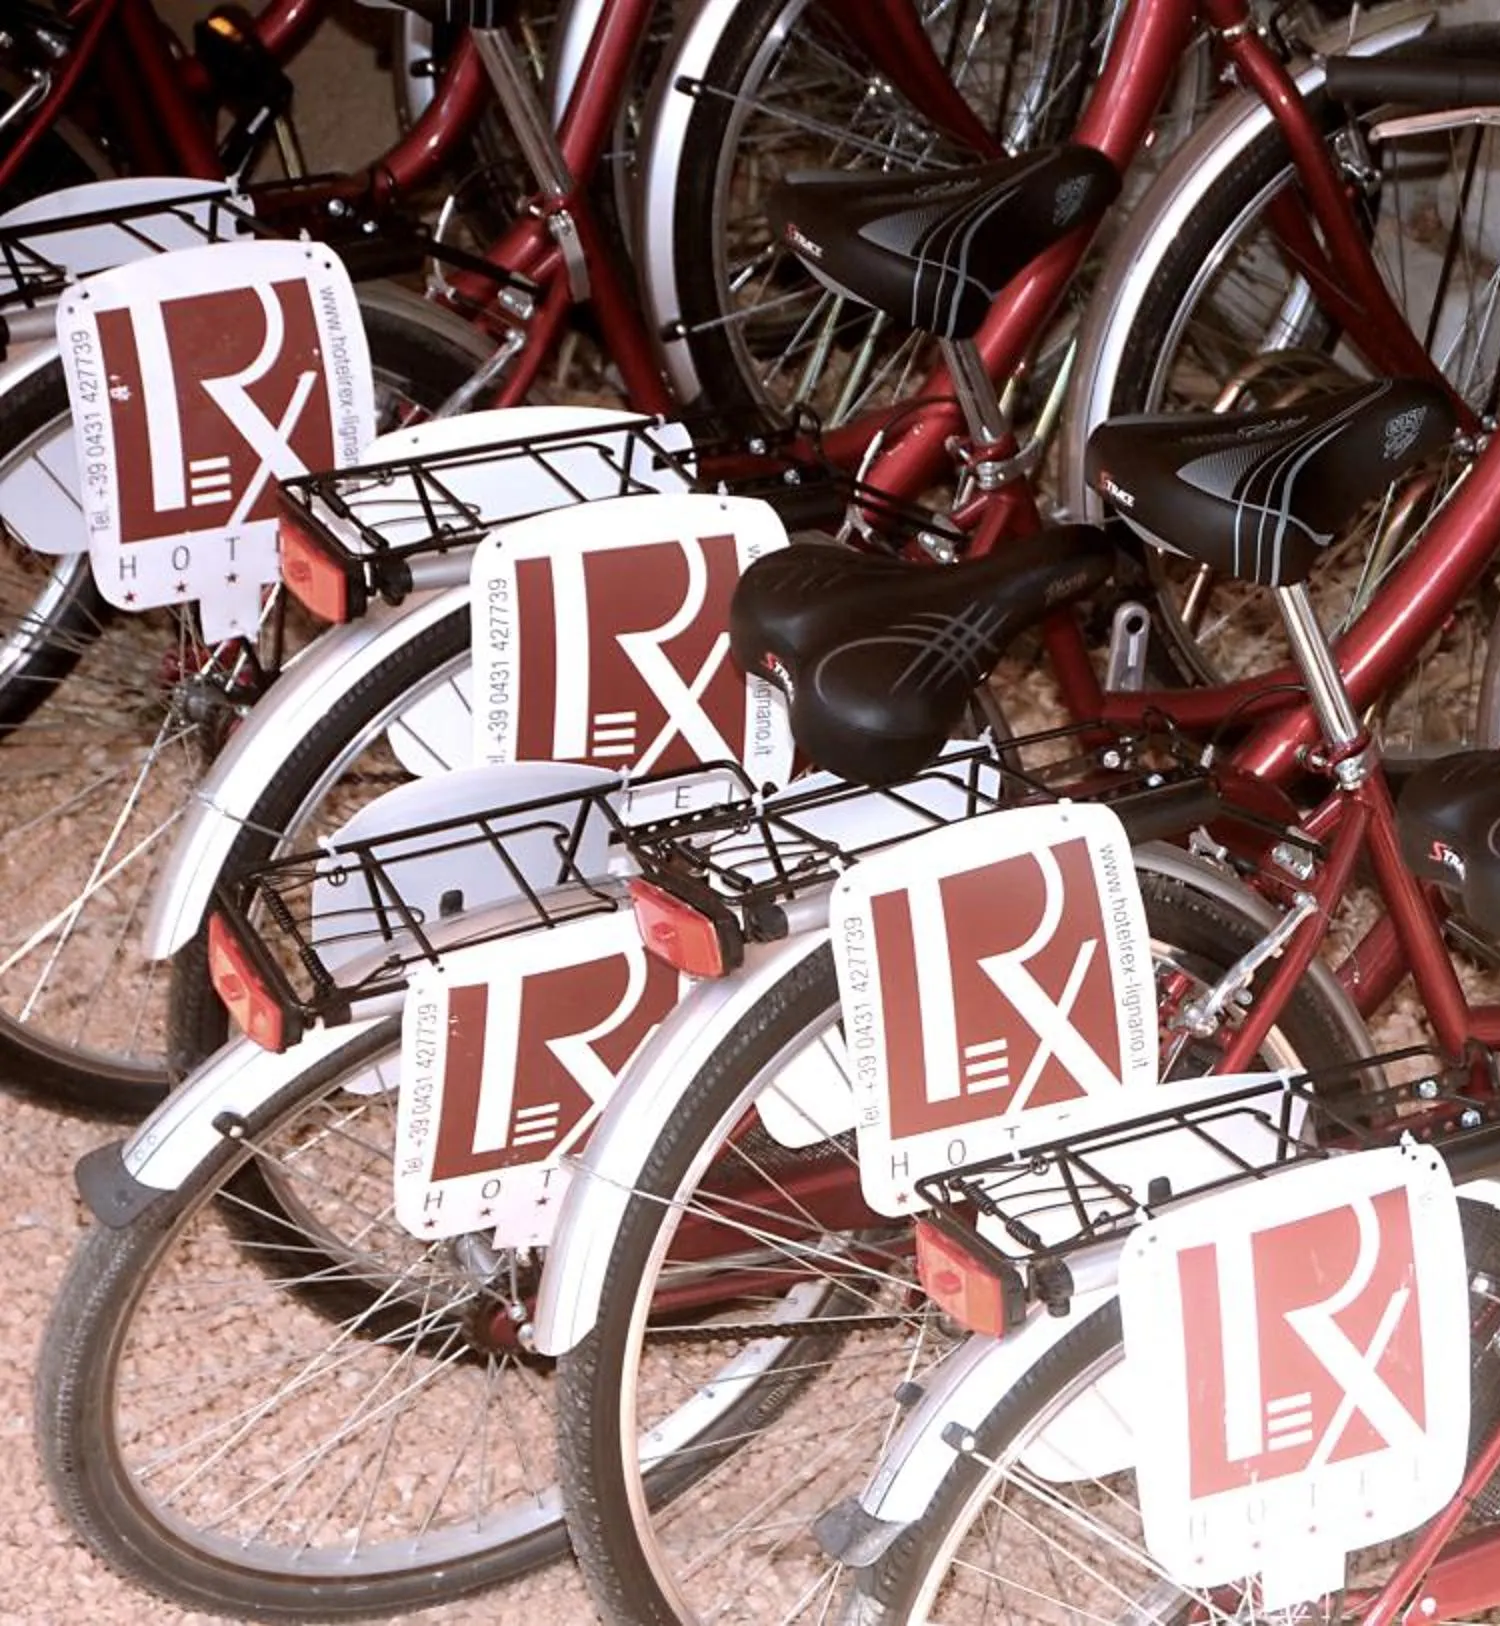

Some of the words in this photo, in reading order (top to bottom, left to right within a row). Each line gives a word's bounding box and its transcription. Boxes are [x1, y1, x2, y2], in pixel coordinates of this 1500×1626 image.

[71, 330, 98, 403] 427739
[319, 285, 361, 469] www.hotelrex-lignan
[84, 413, 105, 458] 0431
[88, 463, 108, 498] +39
[487, 577, 510, 652] 427739
[489, 661, 510, 705] 0431
[487, 709, 509, 744] +39
[843, 915, 869, 993] 427739
[1098, 842, 1150, 1071] www.hotelrex-lignano.it
[415, 1002, 438, 1069] 427739
[853, 1001, 876, 1050] 0431
[411, 1074, 434, 1115] 0431
[857, 1055, 877, 1090] +39
[407, 1118, 430, 1148] +39
[423, 1167, 558, 1212] HOT
